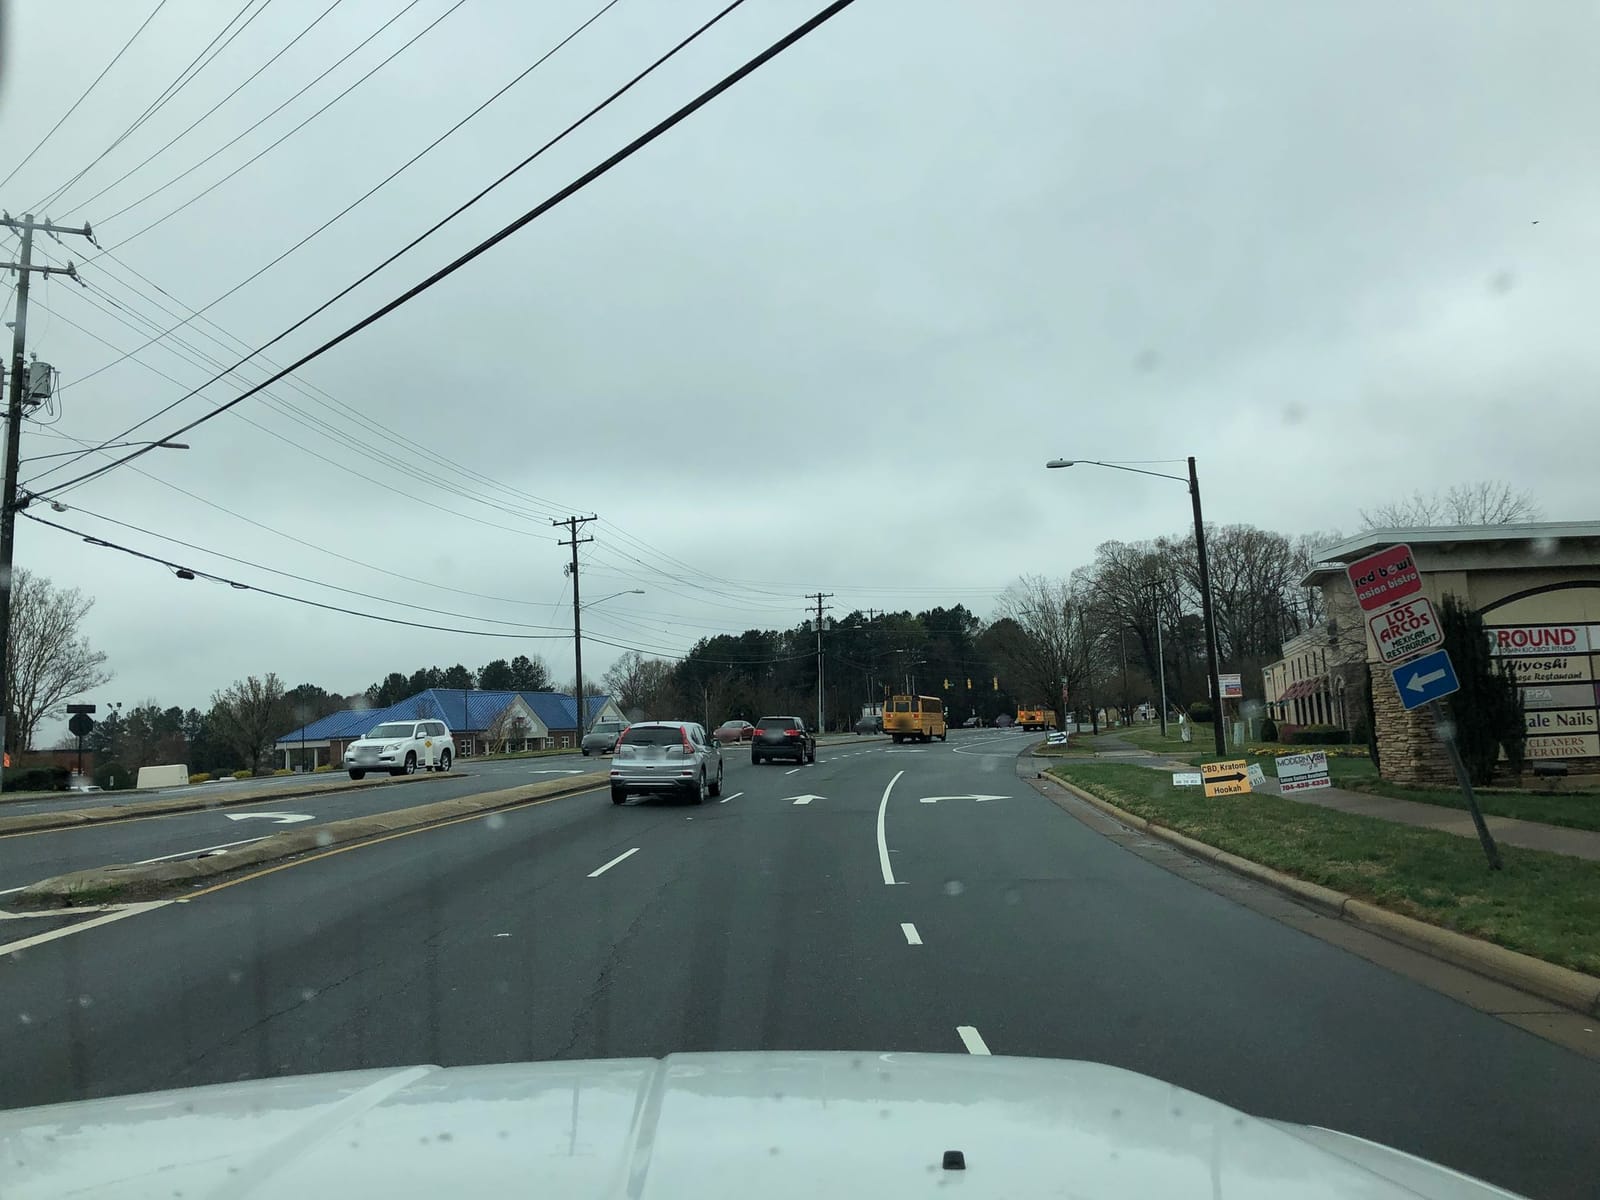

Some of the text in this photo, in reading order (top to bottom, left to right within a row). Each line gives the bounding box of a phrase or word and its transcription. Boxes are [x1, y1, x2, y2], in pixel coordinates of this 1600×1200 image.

[1355, 557, 1413, 588] red bowl
[1359, 571, 1417, 601] asian bistro
[1385, 606, 1415, 626] LOS
[1380, 613, 1430, 643] ARCOS
[1385, 633, 1437, 659] RESTAURANT
[1391, 630, 1426, 649] MEXICAN
[1534, 671, 1582, 681] Restaurant
[1528, 711, 1594, 728] ale Nails
[1528, 737, 1585, 748] CLEANERS
[1525, 747, 1586, 757] TERATIONS
[1219, 762, 1247, 772] Kratom
[1213, 785, 1242, 794] Hookah
